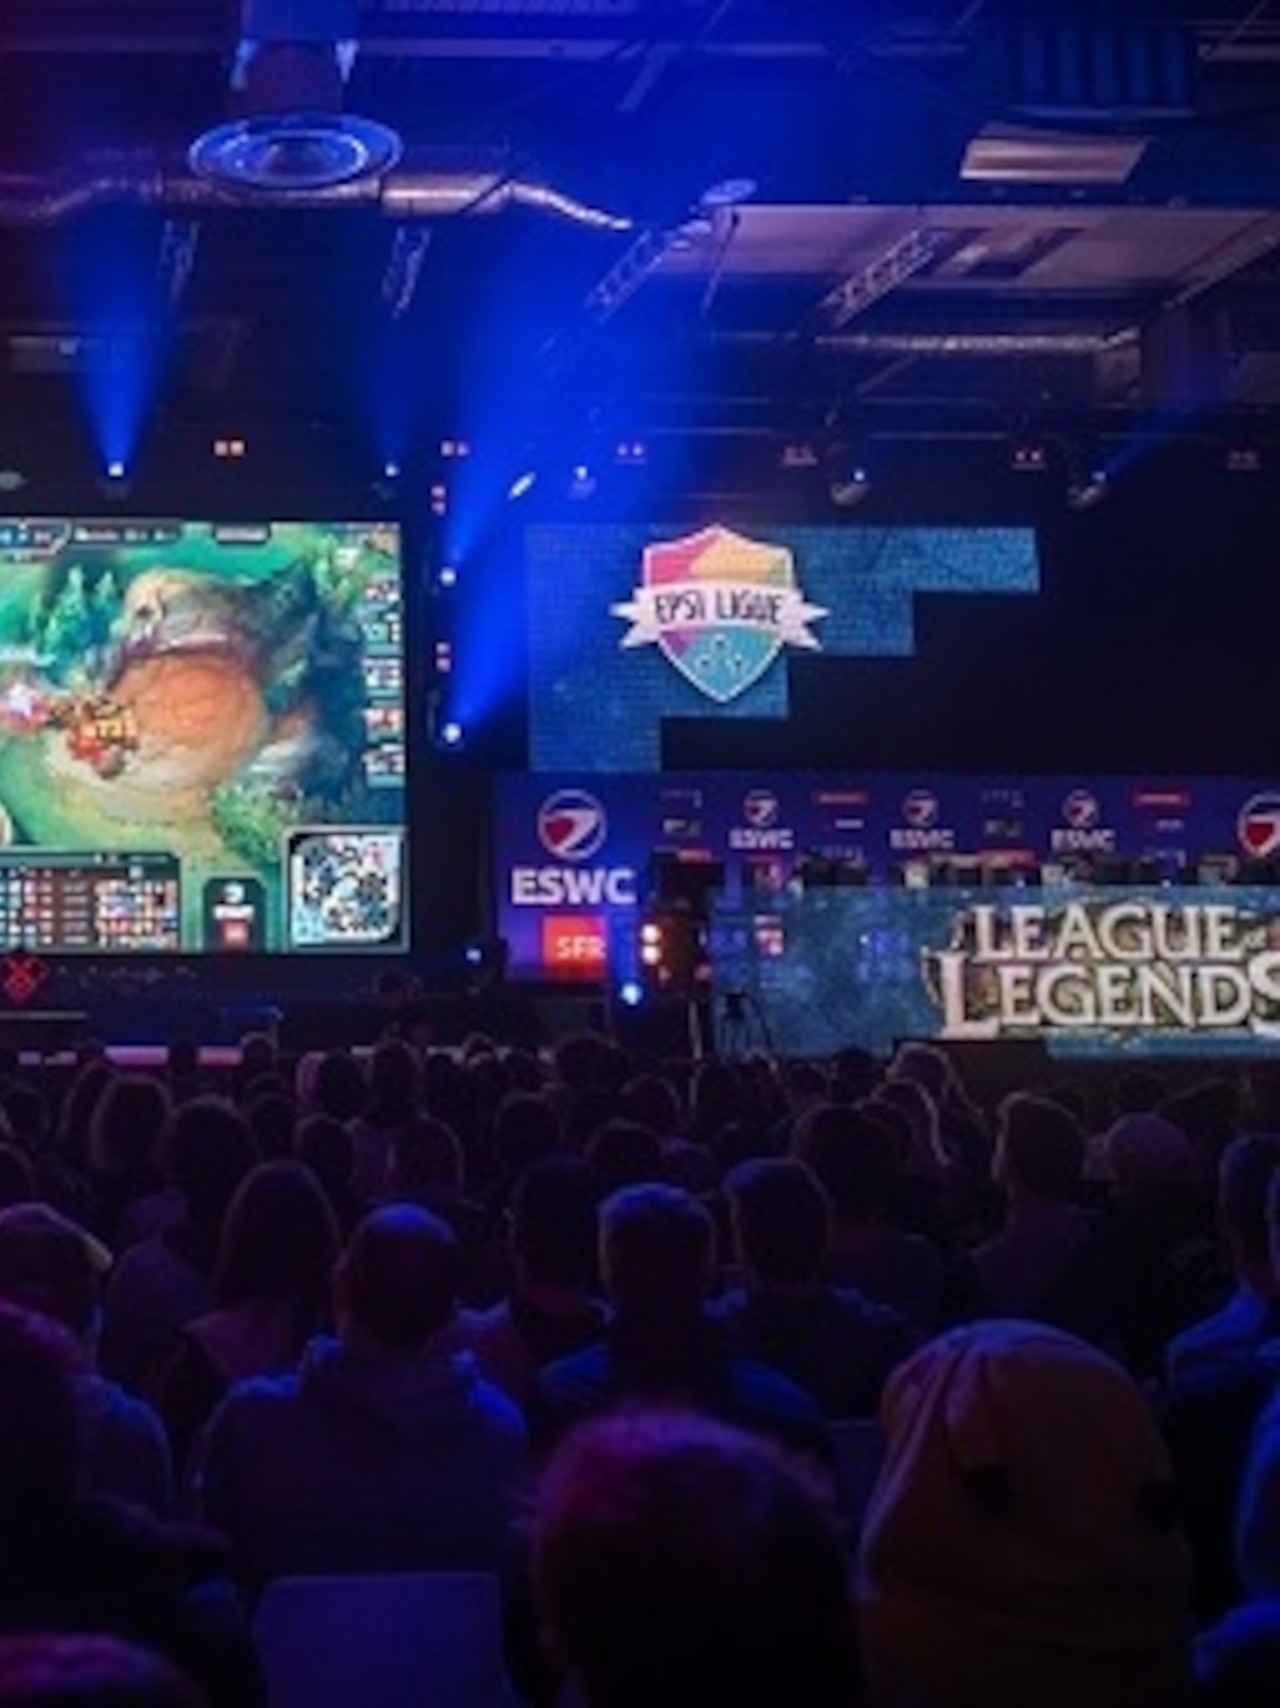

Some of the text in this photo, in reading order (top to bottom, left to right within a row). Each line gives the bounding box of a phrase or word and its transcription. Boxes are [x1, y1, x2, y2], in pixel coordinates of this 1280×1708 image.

[654, 589, 783, 624] EPSI LIGUE
[728, 828, 794, 849] ESWC
[511, 868, 638, 904] ESWC
[557, 935, 607, 960] SFR
[970, 903, 1246, 960] LEAGUE
